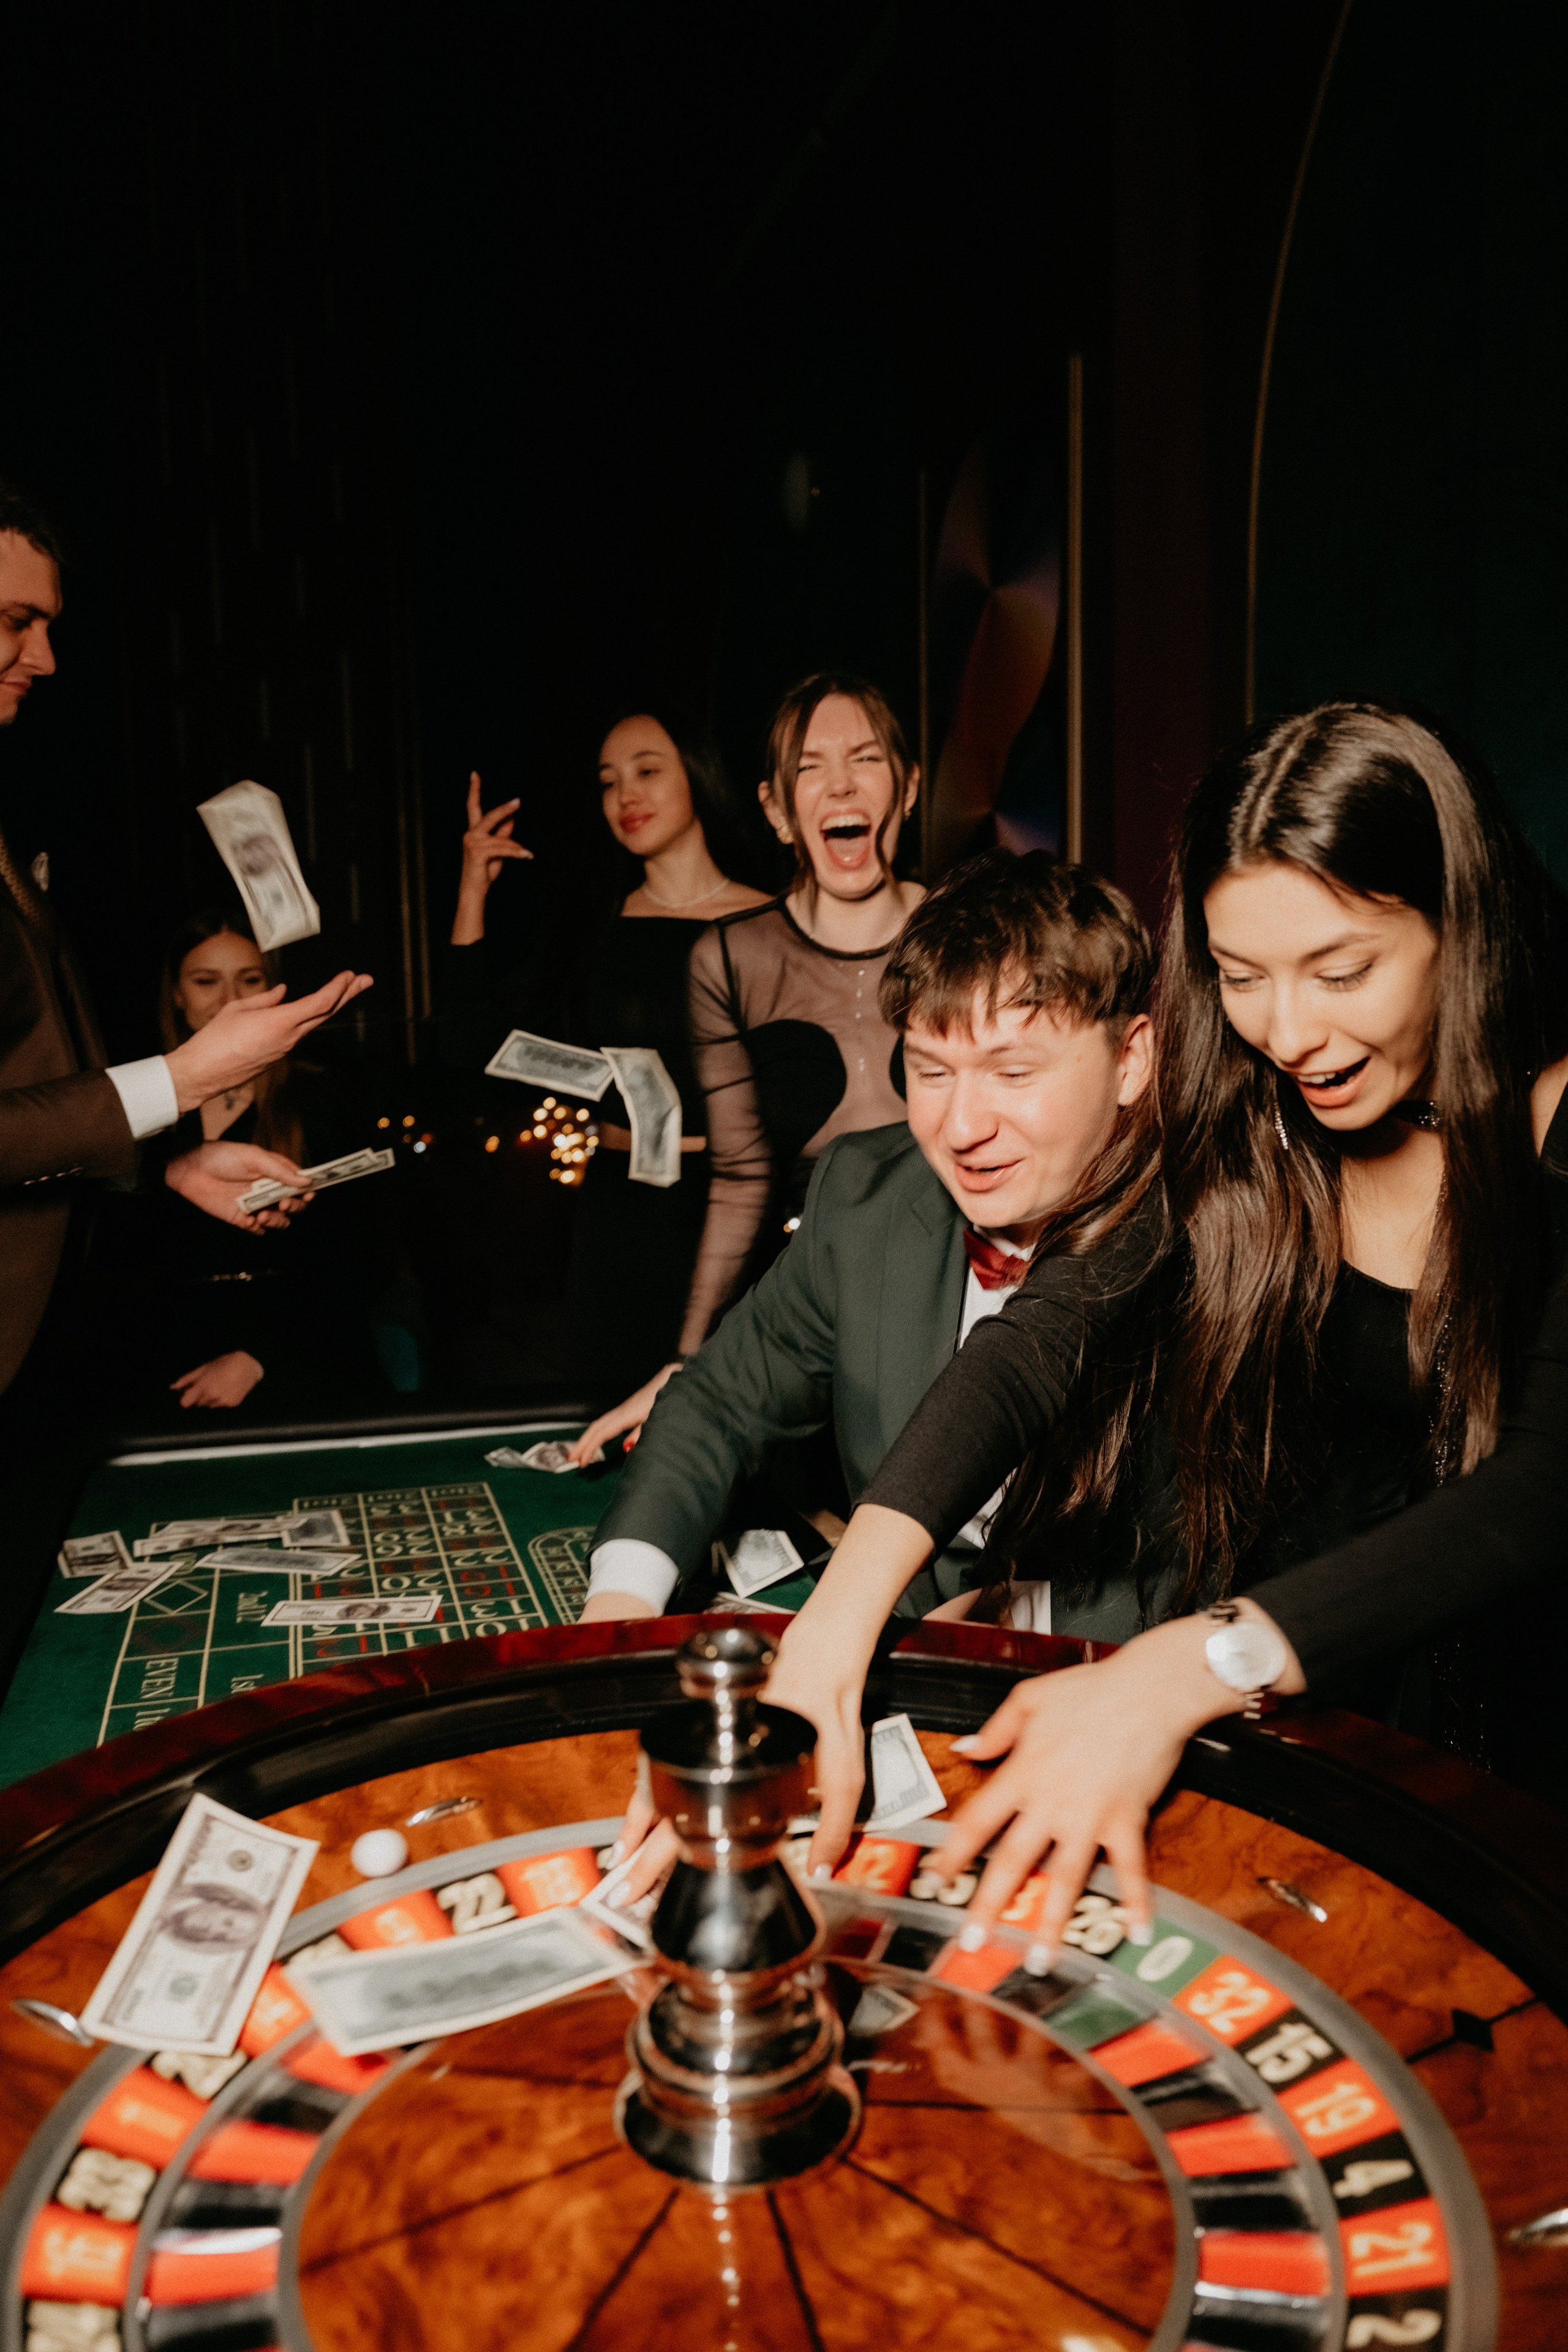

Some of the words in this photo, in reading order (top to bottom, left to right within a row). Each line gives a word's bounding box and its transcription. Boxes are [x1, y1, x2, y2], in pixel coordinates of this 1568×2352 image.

[470, 1599, 524, 1619] 13
[139, 1657, 179, 1700] EVEN
[437, 1872, 518, 1934] 22
[1136, 1936, 1194, 1981] 0
[1188, 1971, 1271, 2034] 32
[1245, 2022, 1333, 2082] 15
[1295, 2082, 1377, 2136] 19
[1333, 2159, 1414, 2198] 4
[1349, 2222, 1434, 2278] 21
[1347, 2308, 1442, 2348] 2
